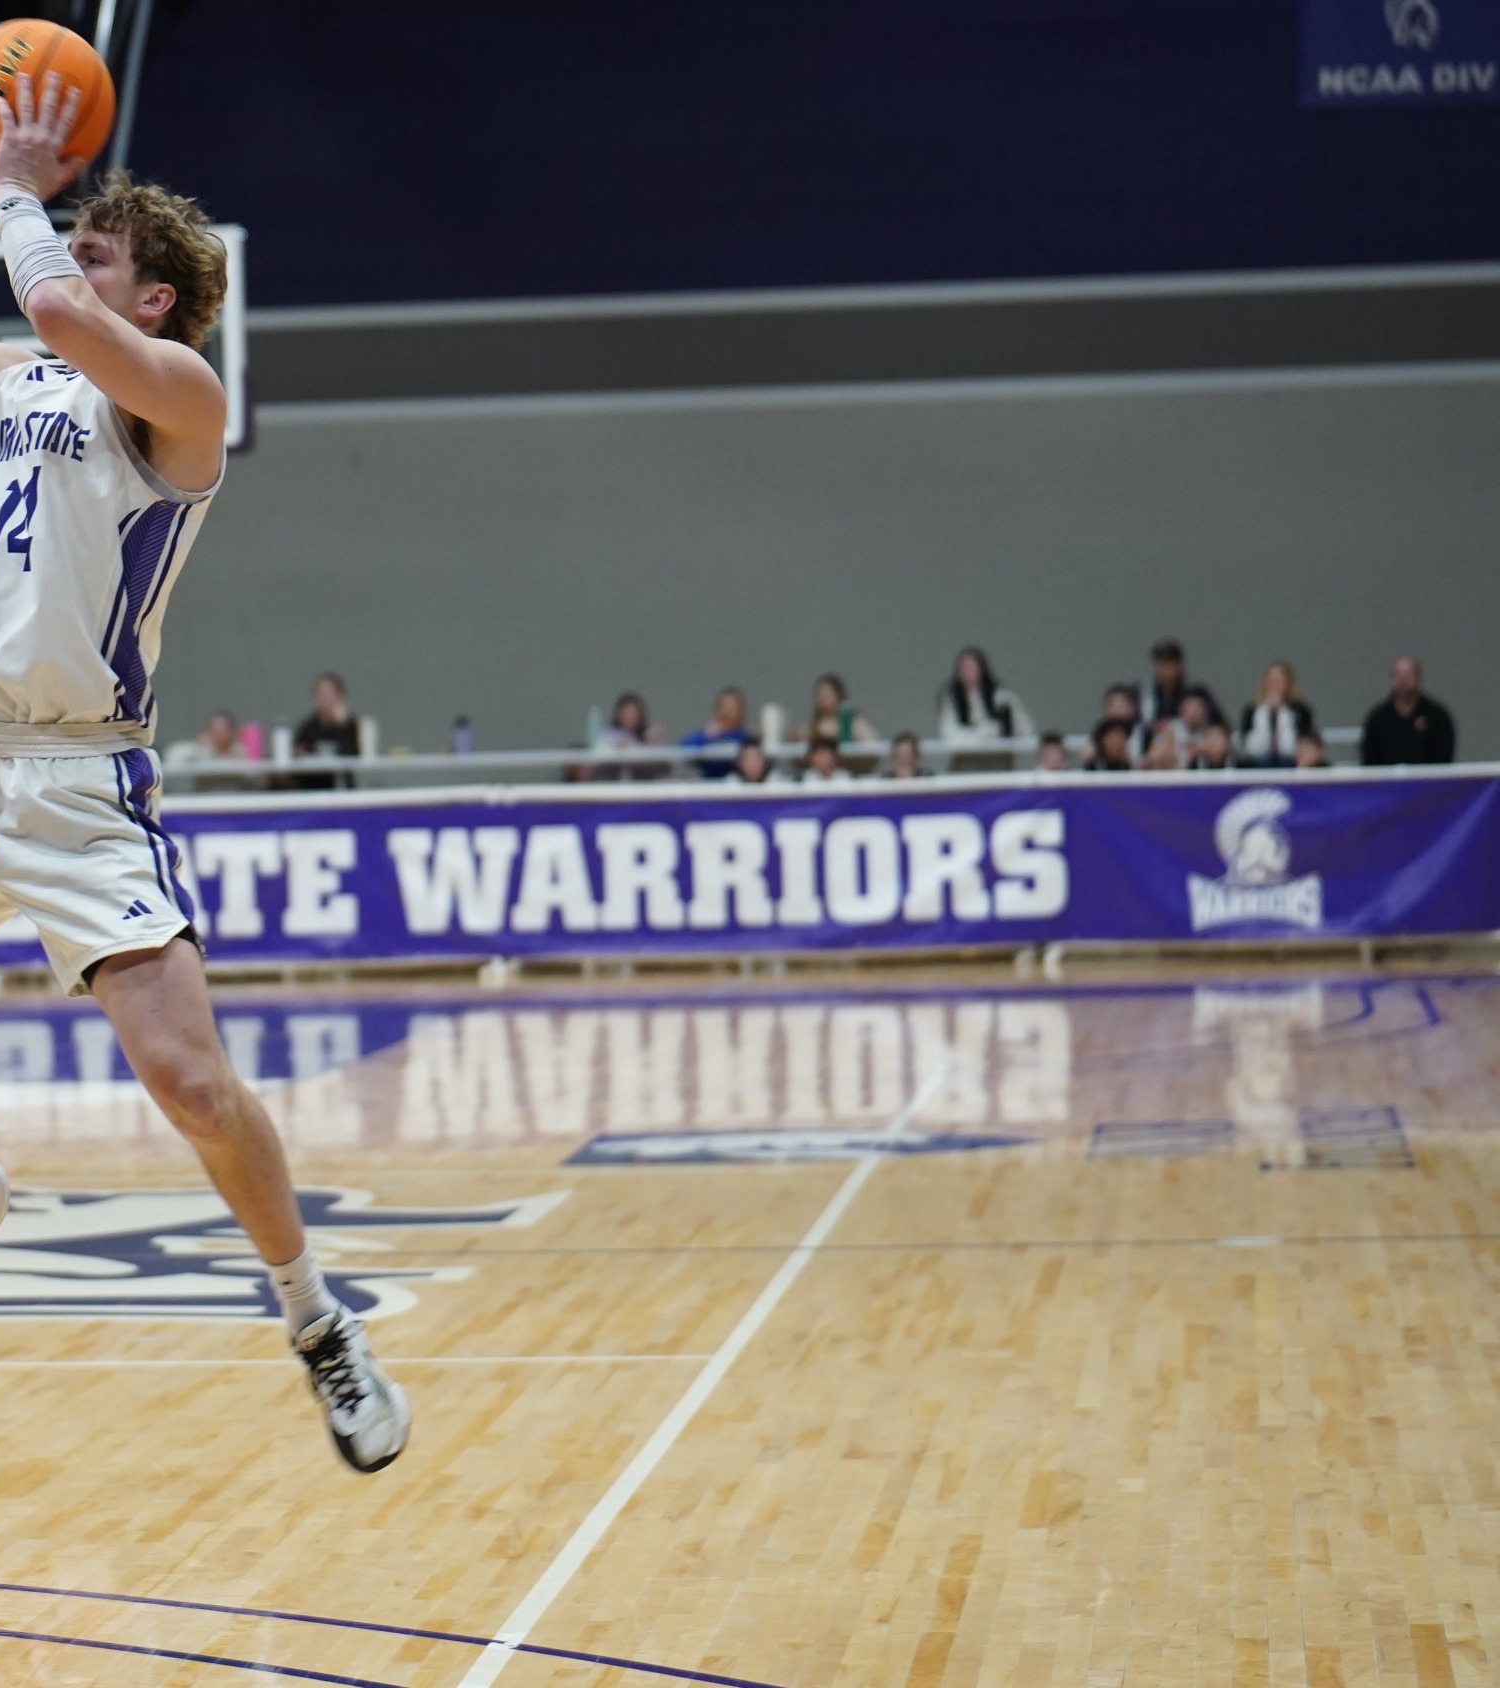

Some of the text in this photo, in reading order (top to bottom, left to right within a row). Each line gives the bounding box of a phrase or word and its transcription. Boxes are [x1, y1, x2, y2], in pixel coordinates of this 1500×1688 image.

[1318, 61, 1496, 95] NCAA DIV
[25, 411, 91, 462] STATE
[387, 809, 1069, 937] WARRIORS
